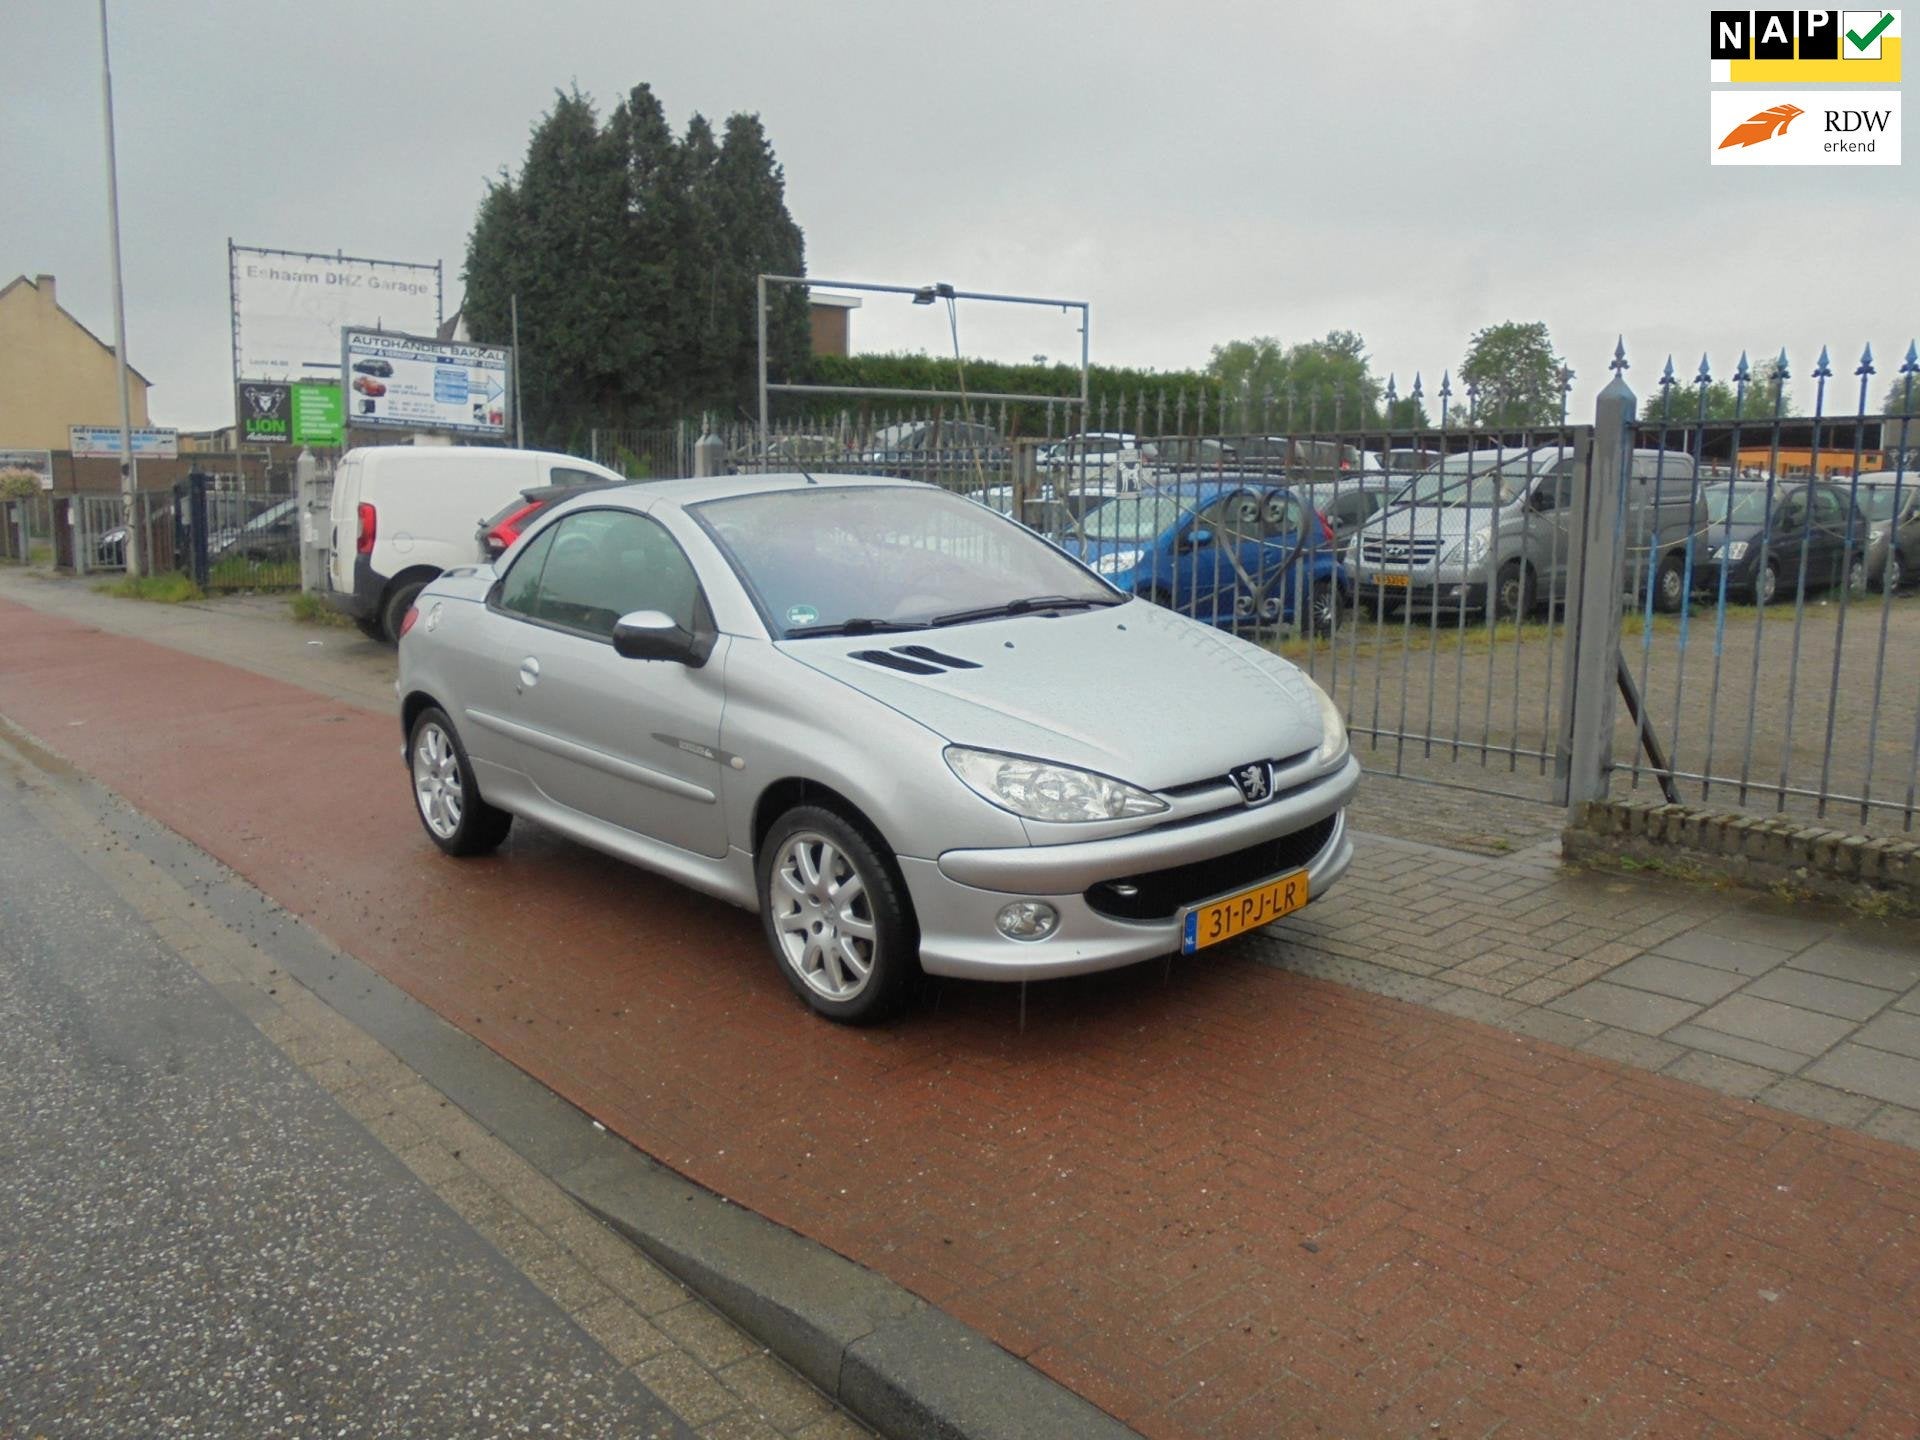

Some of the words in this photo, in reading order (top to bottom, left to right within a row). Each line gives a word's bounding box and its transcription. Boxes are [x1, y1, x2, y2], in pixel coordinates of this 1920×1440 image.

[325, 272, 363, 288] DHZ
[367, 277, 429, 295] Garage
[352, 335, 447, 354] AUTOHANDEL
[246, 419, 286, 432] LION
[1209, 881, 1296, 938] 31-PJ-LR
[1185, 936, 1195, 945] NL
